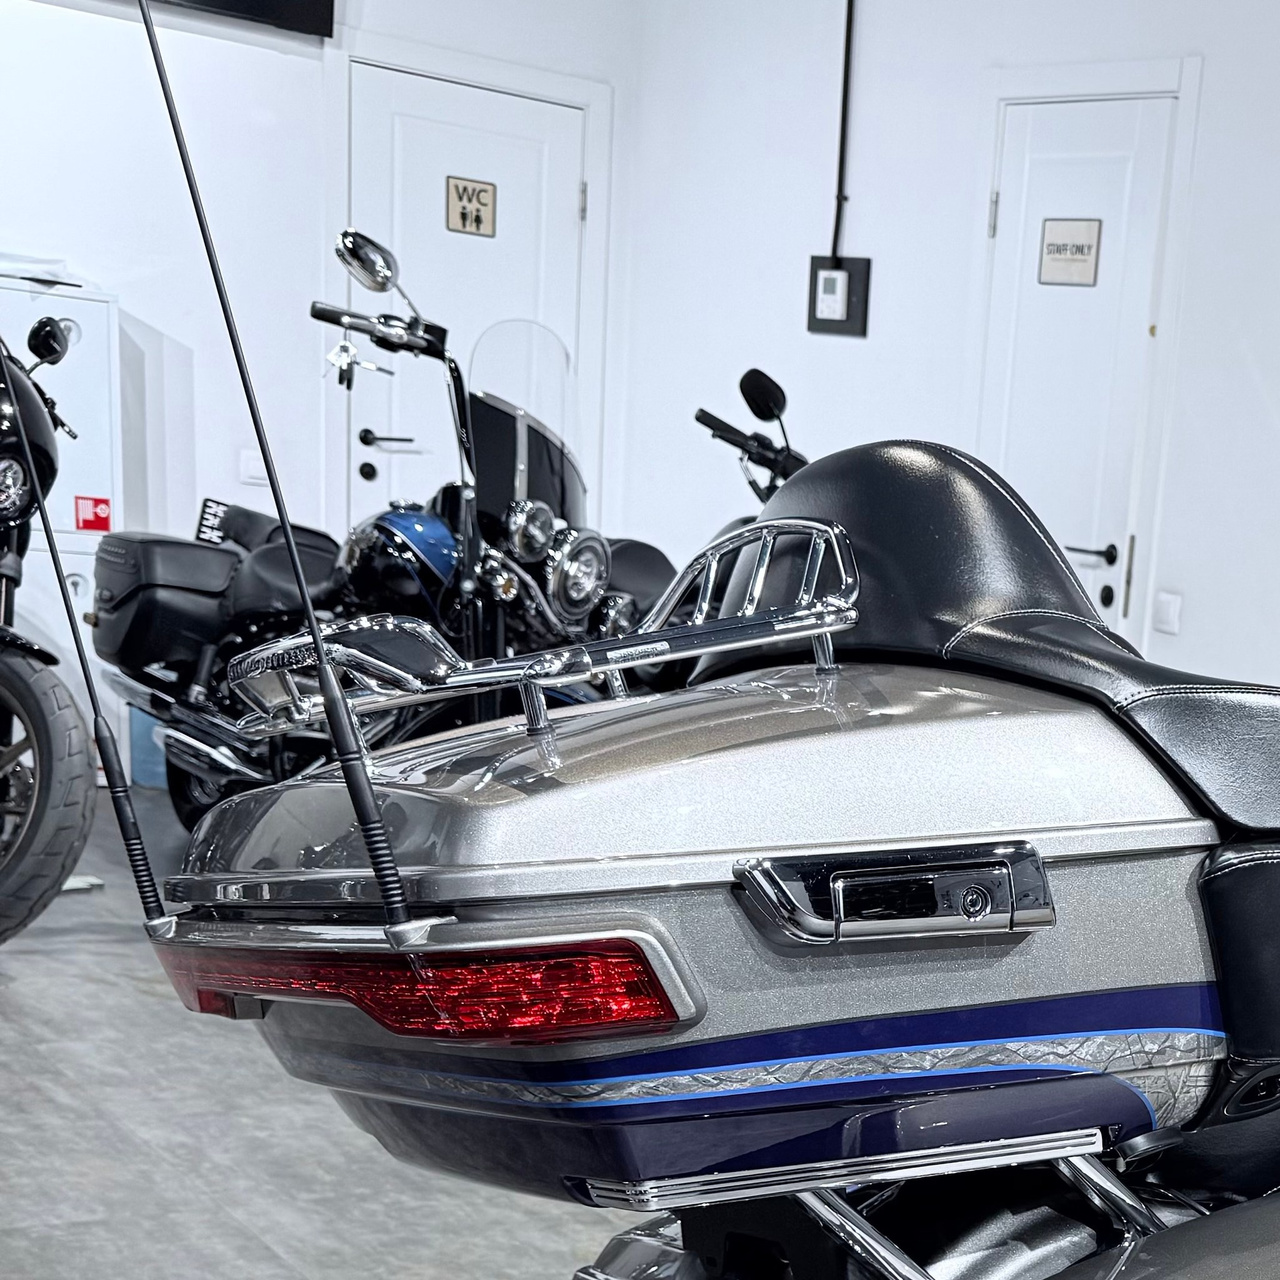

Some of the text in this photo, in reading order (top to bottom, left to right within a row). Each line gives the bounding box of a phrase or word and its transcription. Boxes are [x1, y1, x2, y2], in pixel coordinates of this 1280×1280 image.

[453, 183, 489, 207] WC
[1046, 242, 1093, 257] STAFF ONLY
